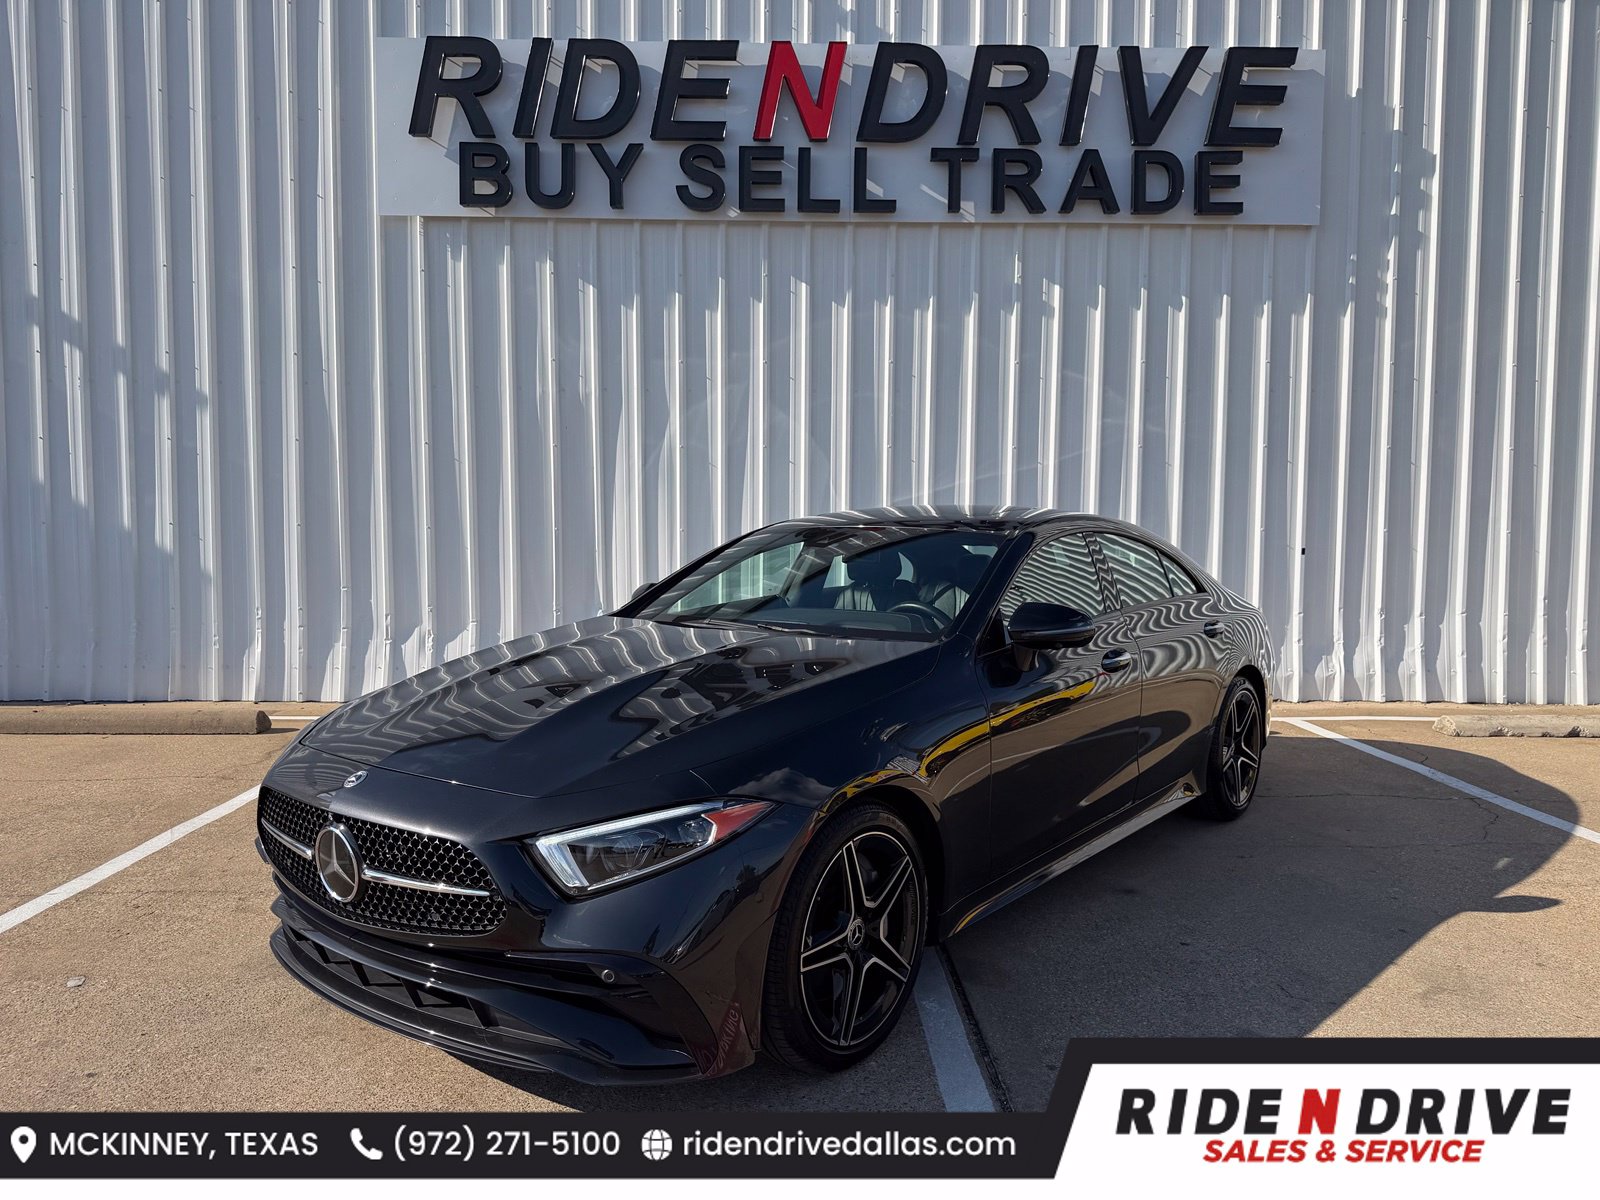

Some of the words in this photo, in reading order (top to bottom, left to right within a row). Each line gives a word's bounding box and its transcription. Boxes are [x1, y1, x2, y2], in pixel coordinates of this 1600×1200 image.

[458, 141, 644, 210] BUY
[676, 143, 897, 214] SELL
[930, 147, 1244, 216] TRADE
